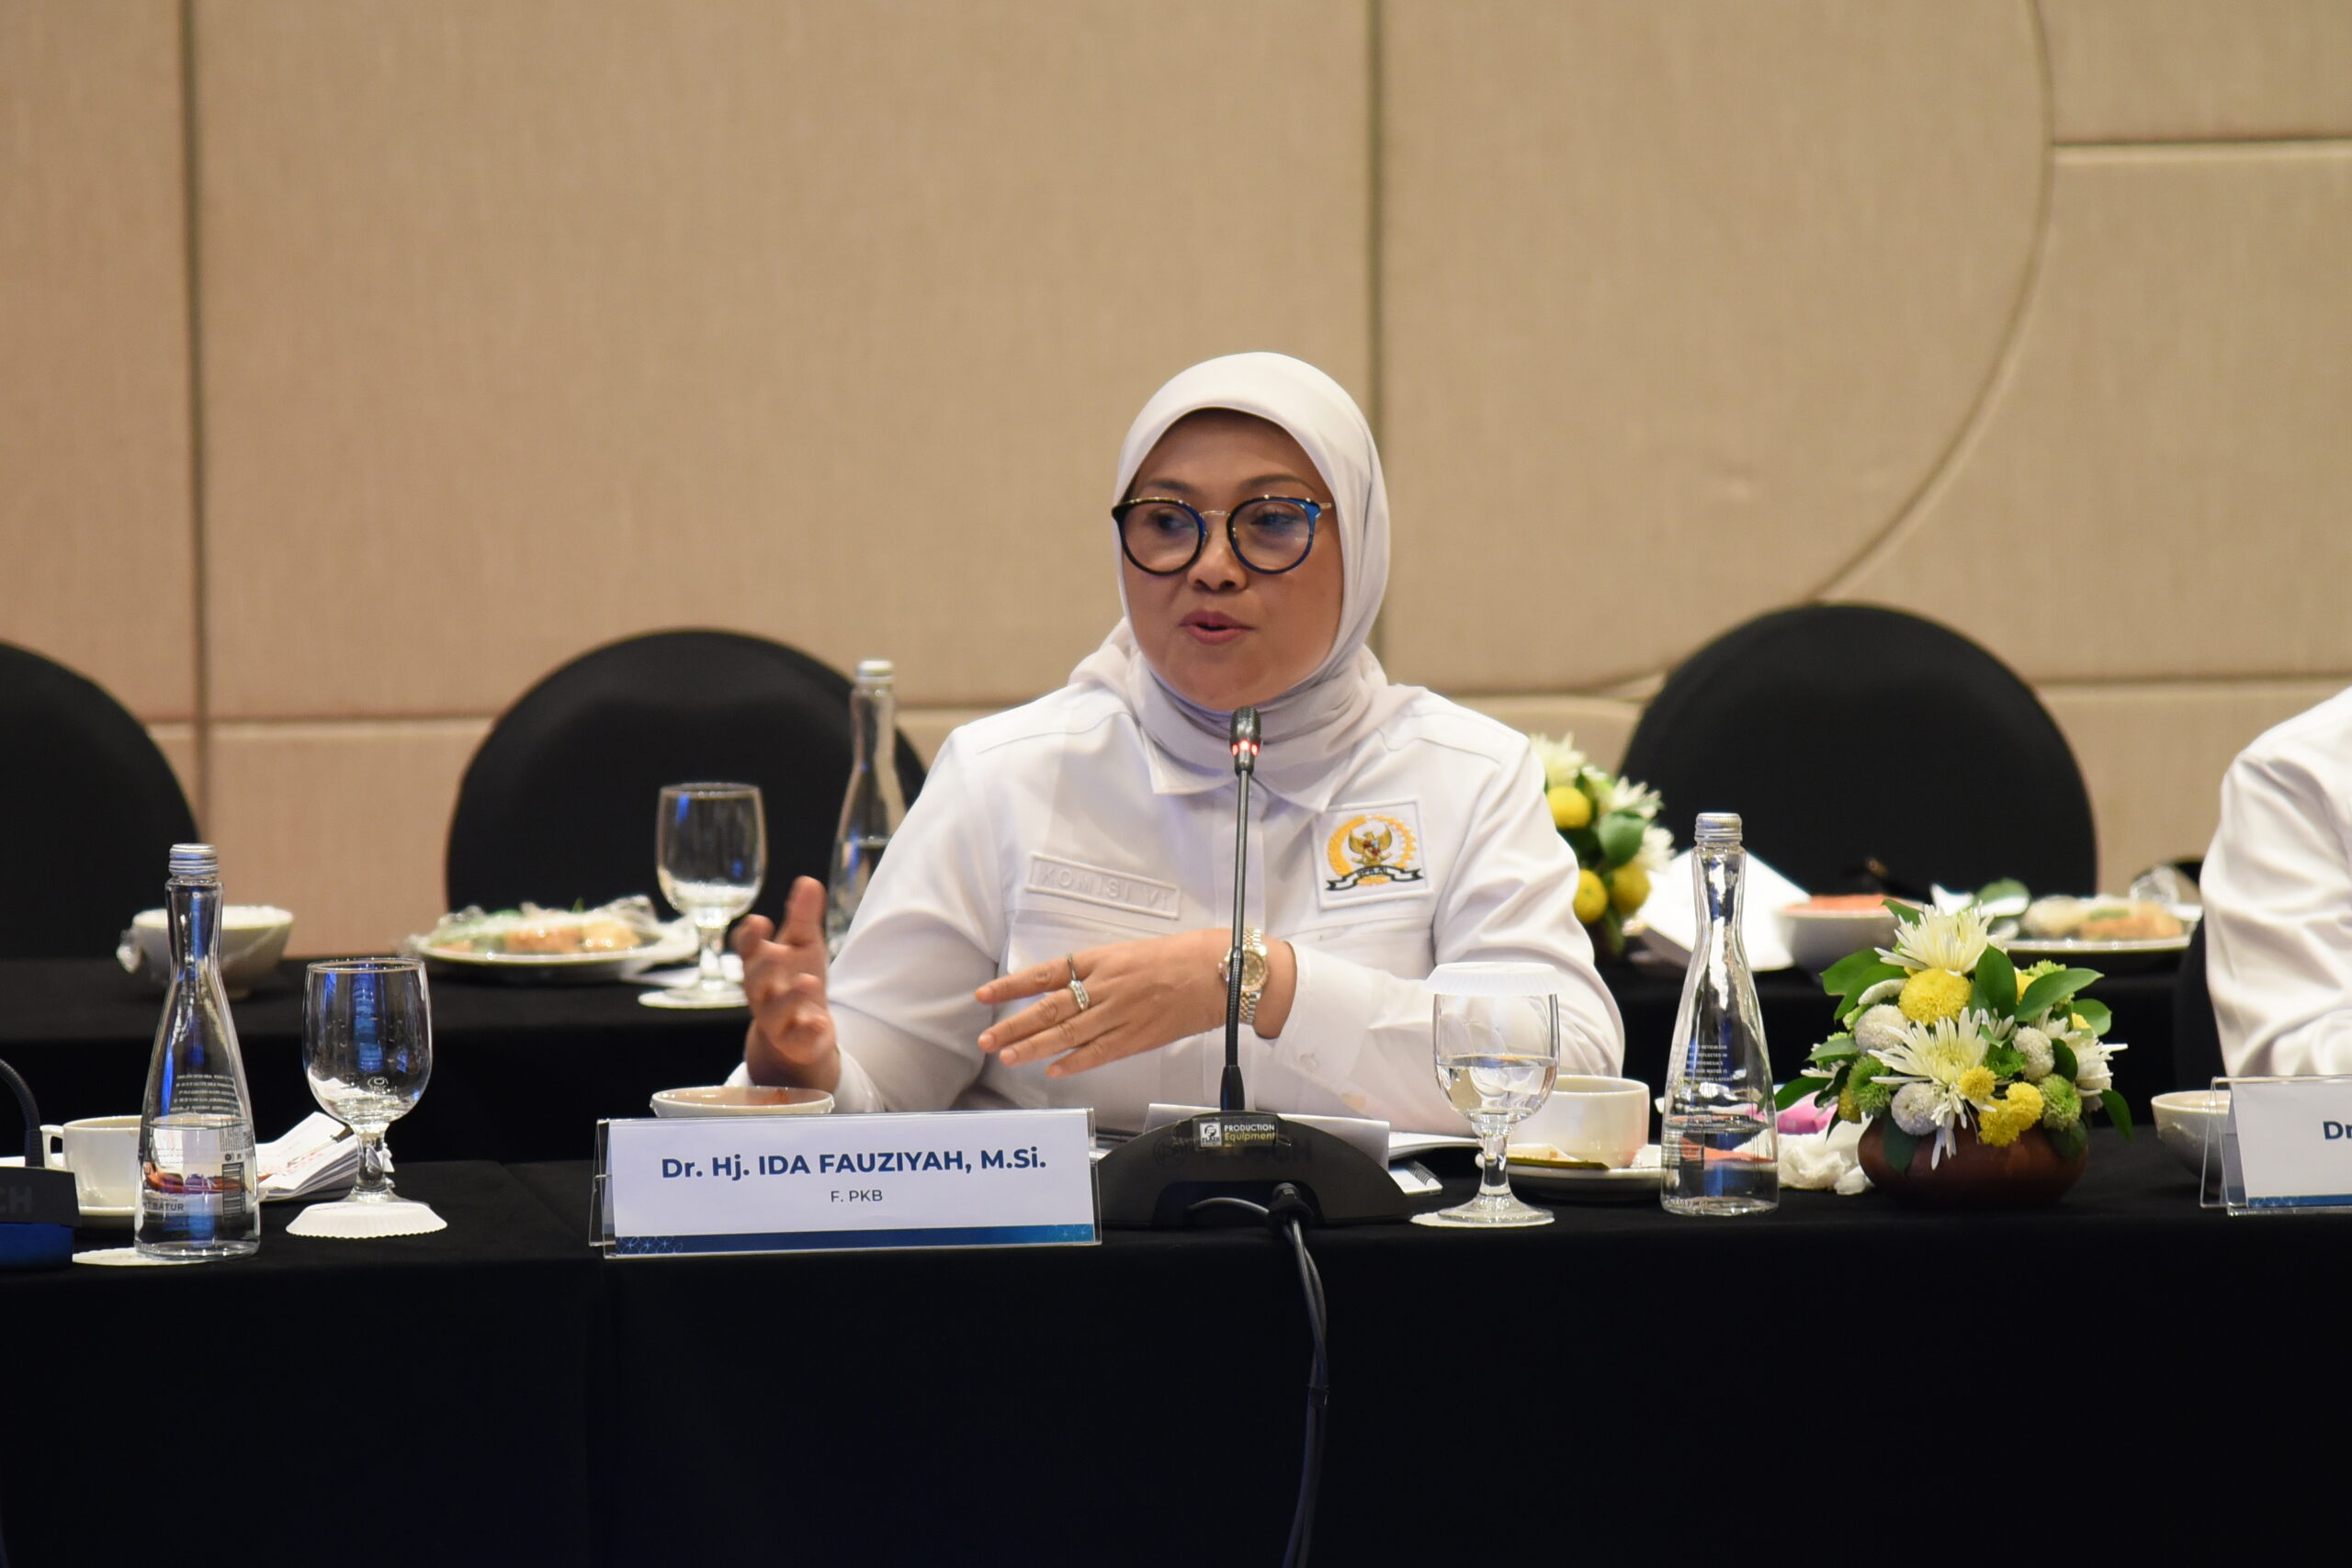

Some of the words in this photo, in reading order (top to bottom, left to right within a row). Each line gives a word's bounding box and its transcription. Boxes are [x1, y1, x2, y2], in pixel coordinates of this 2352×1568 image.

[1040, 866, 1131, 901] KOMISI
[1224, 1123, 1275, 1132] PRODUCTION
[1224, 1132, 1276, 1143] Equipment
[662, 1158, 703, 1179] Dr.
[712, 1153, 750, 1181] Hj.
[758, 1155, 811, 1176] IDA
[819, 1150, 972, 1174] FAUZIYAH,
[980, 1145, 1046, 1169] M.Si.
[831, 1190, 844, 1203] F.
[848, 1189, 883, 1203] PKB
